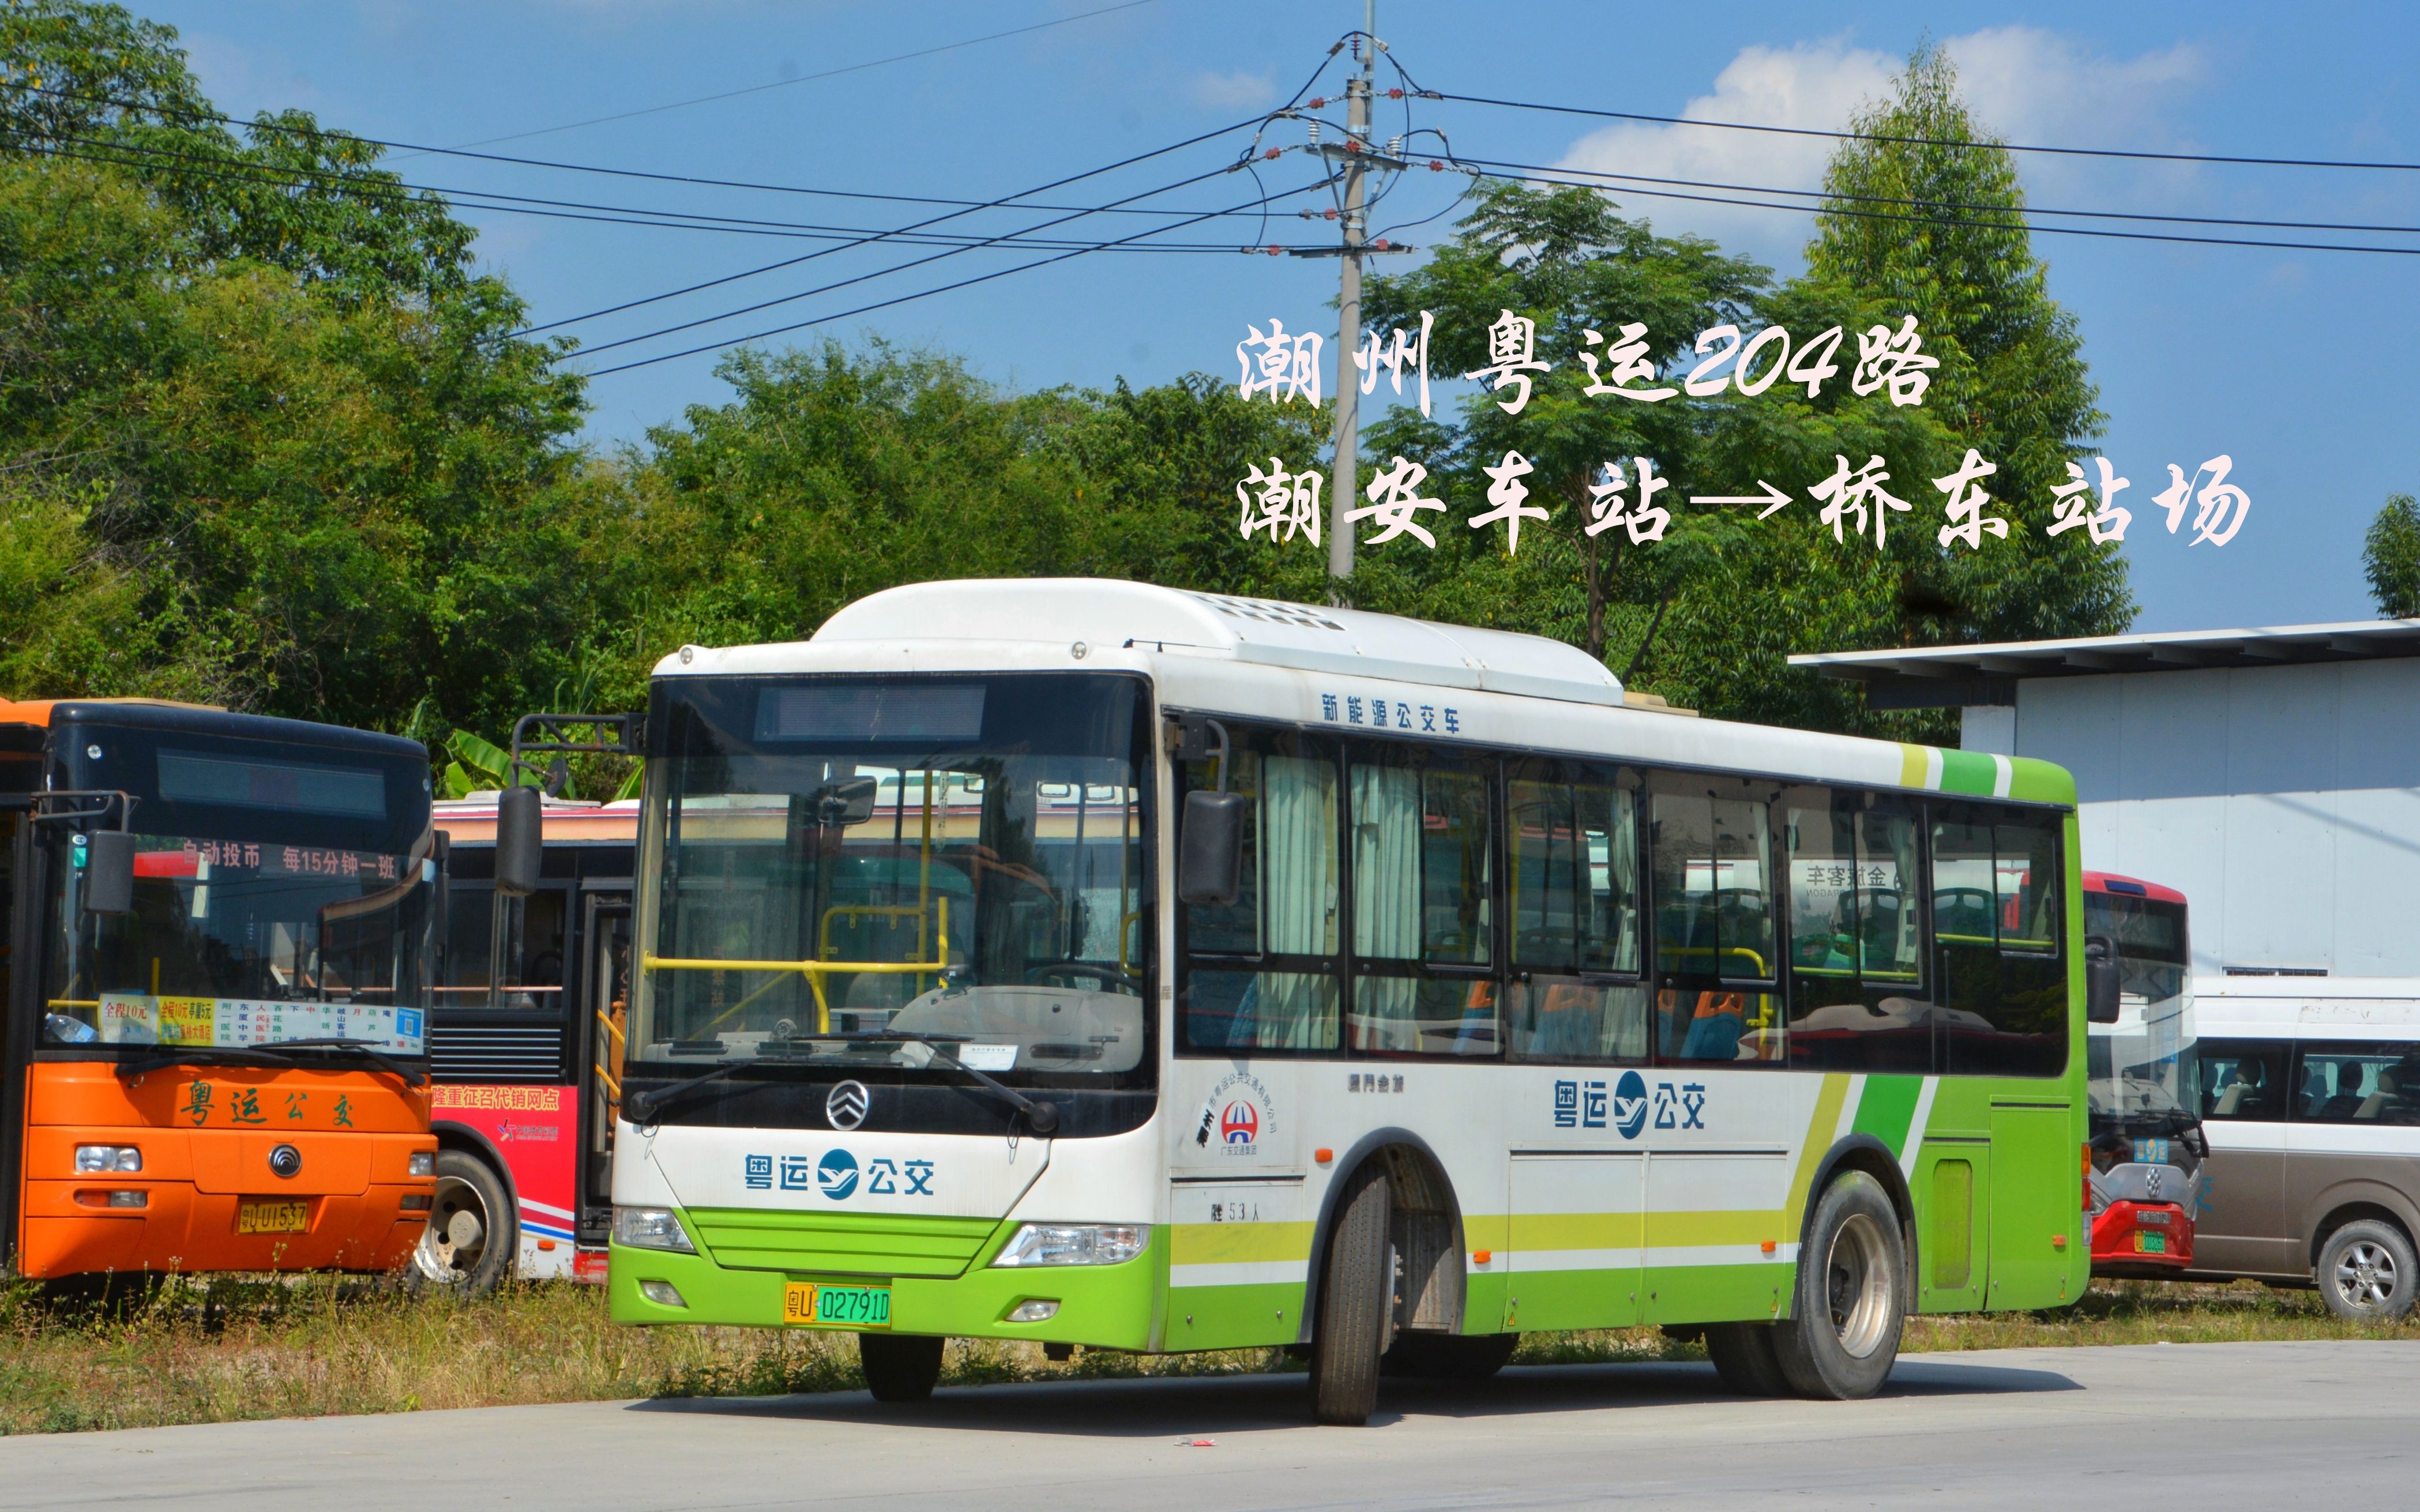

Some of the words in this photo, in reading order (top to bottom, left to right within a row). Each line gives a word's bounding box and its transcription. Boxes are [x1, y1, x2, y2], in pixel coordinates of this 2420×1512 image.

[1321, 692, 1460, 735] 新能源公交车
[183, 840, 260, 868] 自动投币
[283, 846, 395, 879] 每15分钟一班
[105, 1001, 148, 1020] 全程10元
[238, 1003, 249, 1042] 东厦中学
[255, 1005, 266, 1043] 人民医院
[272, 1005, 283, 1043] 百花路口
[181, 1078, 355, 1127] 粤运公交
[431, 1086, 560, 1111] 隆重征召代销网点
[1553, 1079, 1607, 1129] 粤运
[1654, 1082, 1705, 1130] 公交
[1220, 1145, 1257, 1156] 广东交通集团
[745, 1154, 809, 1190] 粤运
[868, 1159, 935, 1196] 公交
